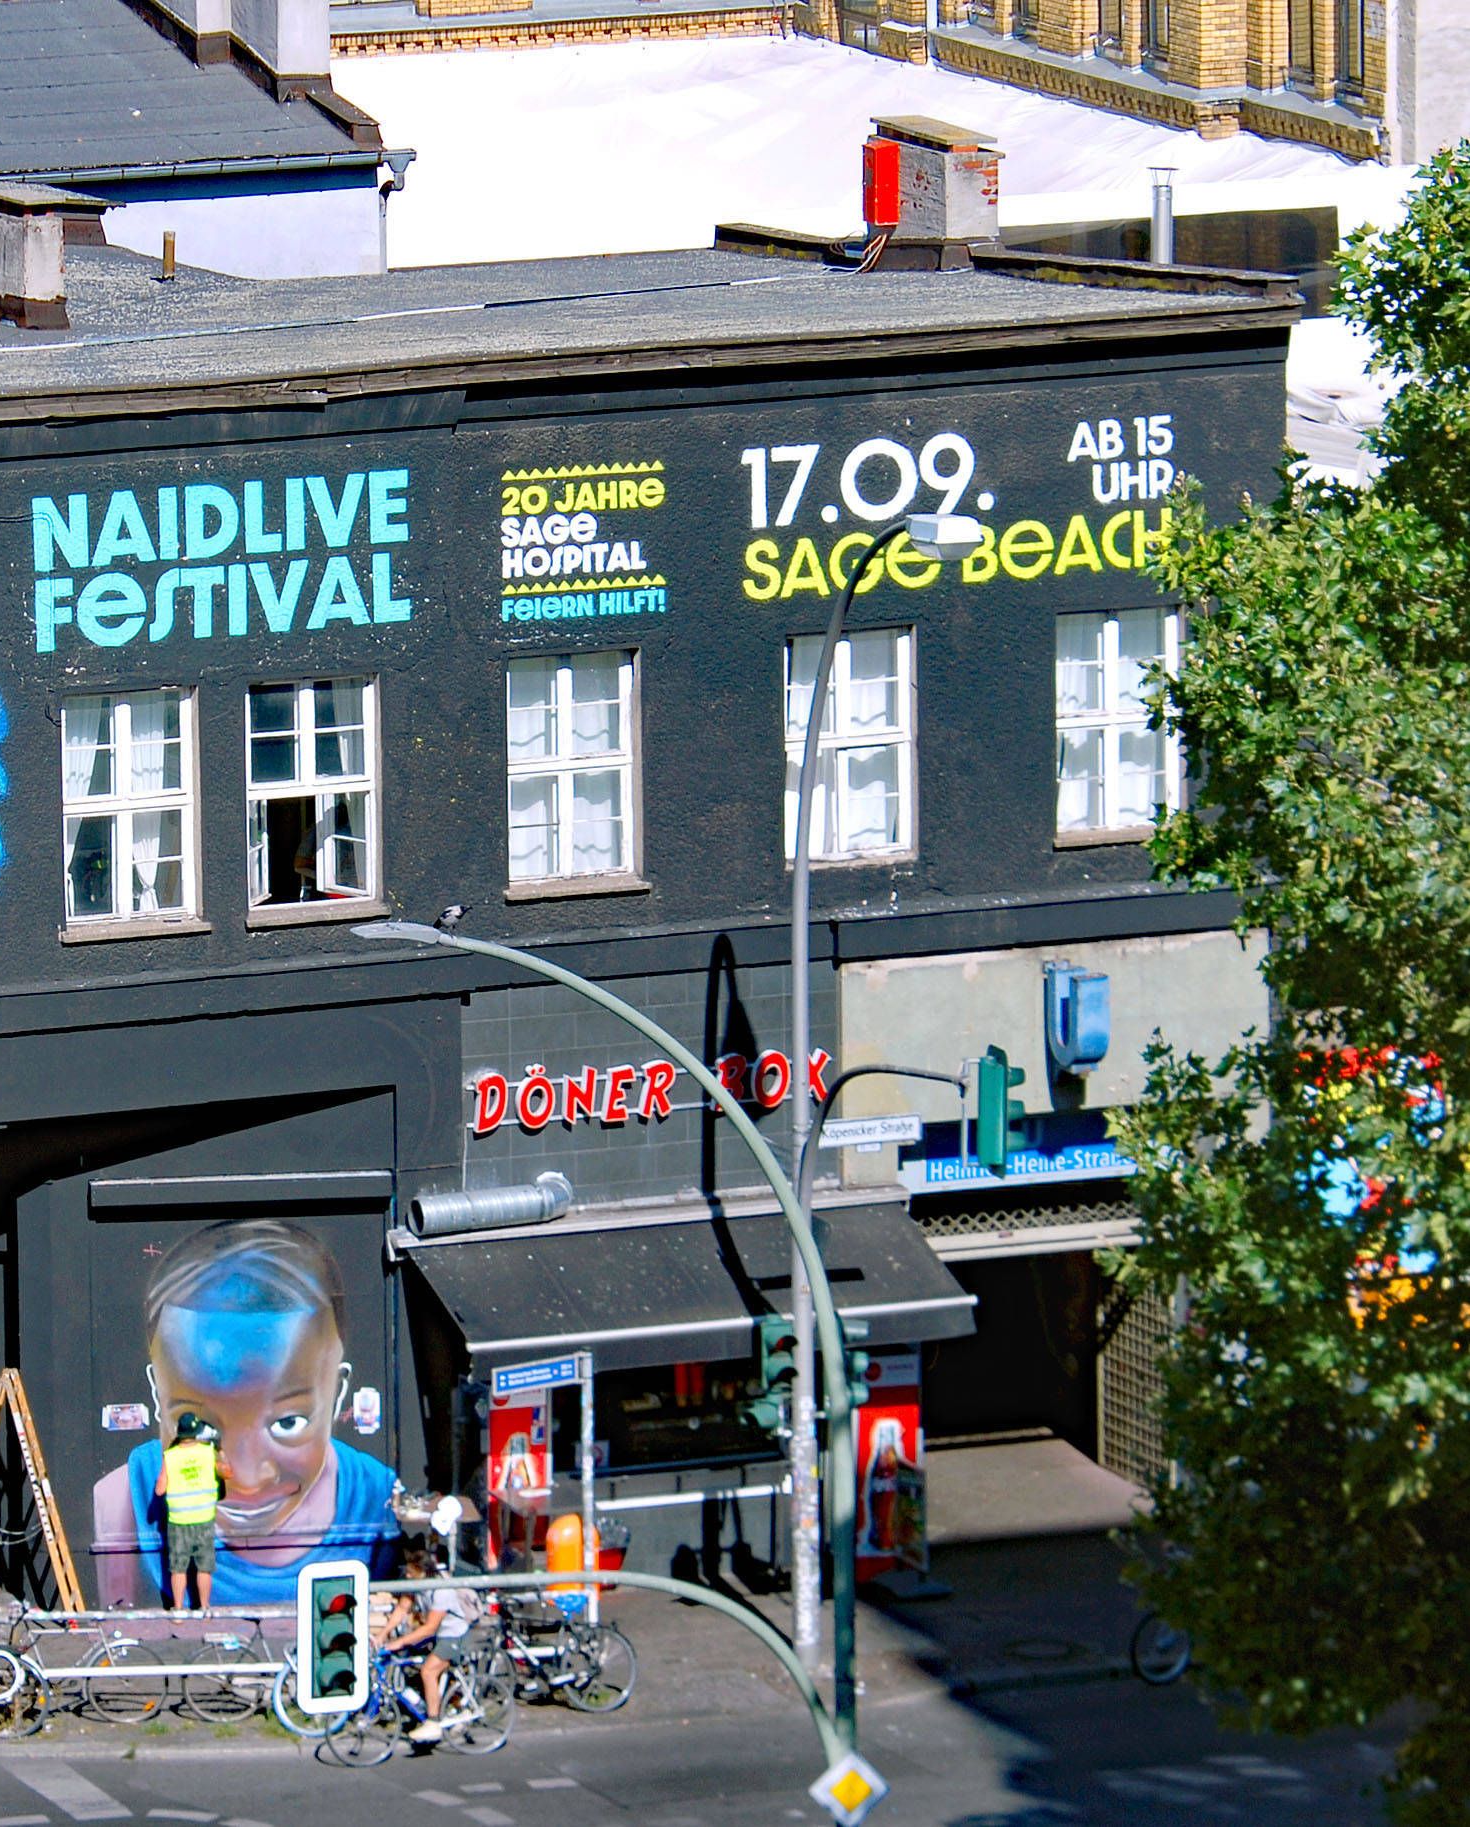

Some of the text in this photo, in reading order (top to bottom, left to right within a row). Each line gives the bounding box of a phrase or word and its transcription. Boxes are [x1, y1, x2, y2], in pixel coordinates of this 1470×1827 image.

[1067, 414, 1175, 463] AB 15
[501, 485, 548, 517] 20
[740, 431, 996, 530] 17.09.
[1092, 459, 1175, 504] UHR
[31, 468, 410, 572] NAIDLIVE
[501, 540, 648, 579] HOSPITAL
[474, 1059, 677, 1134] DÖNER
